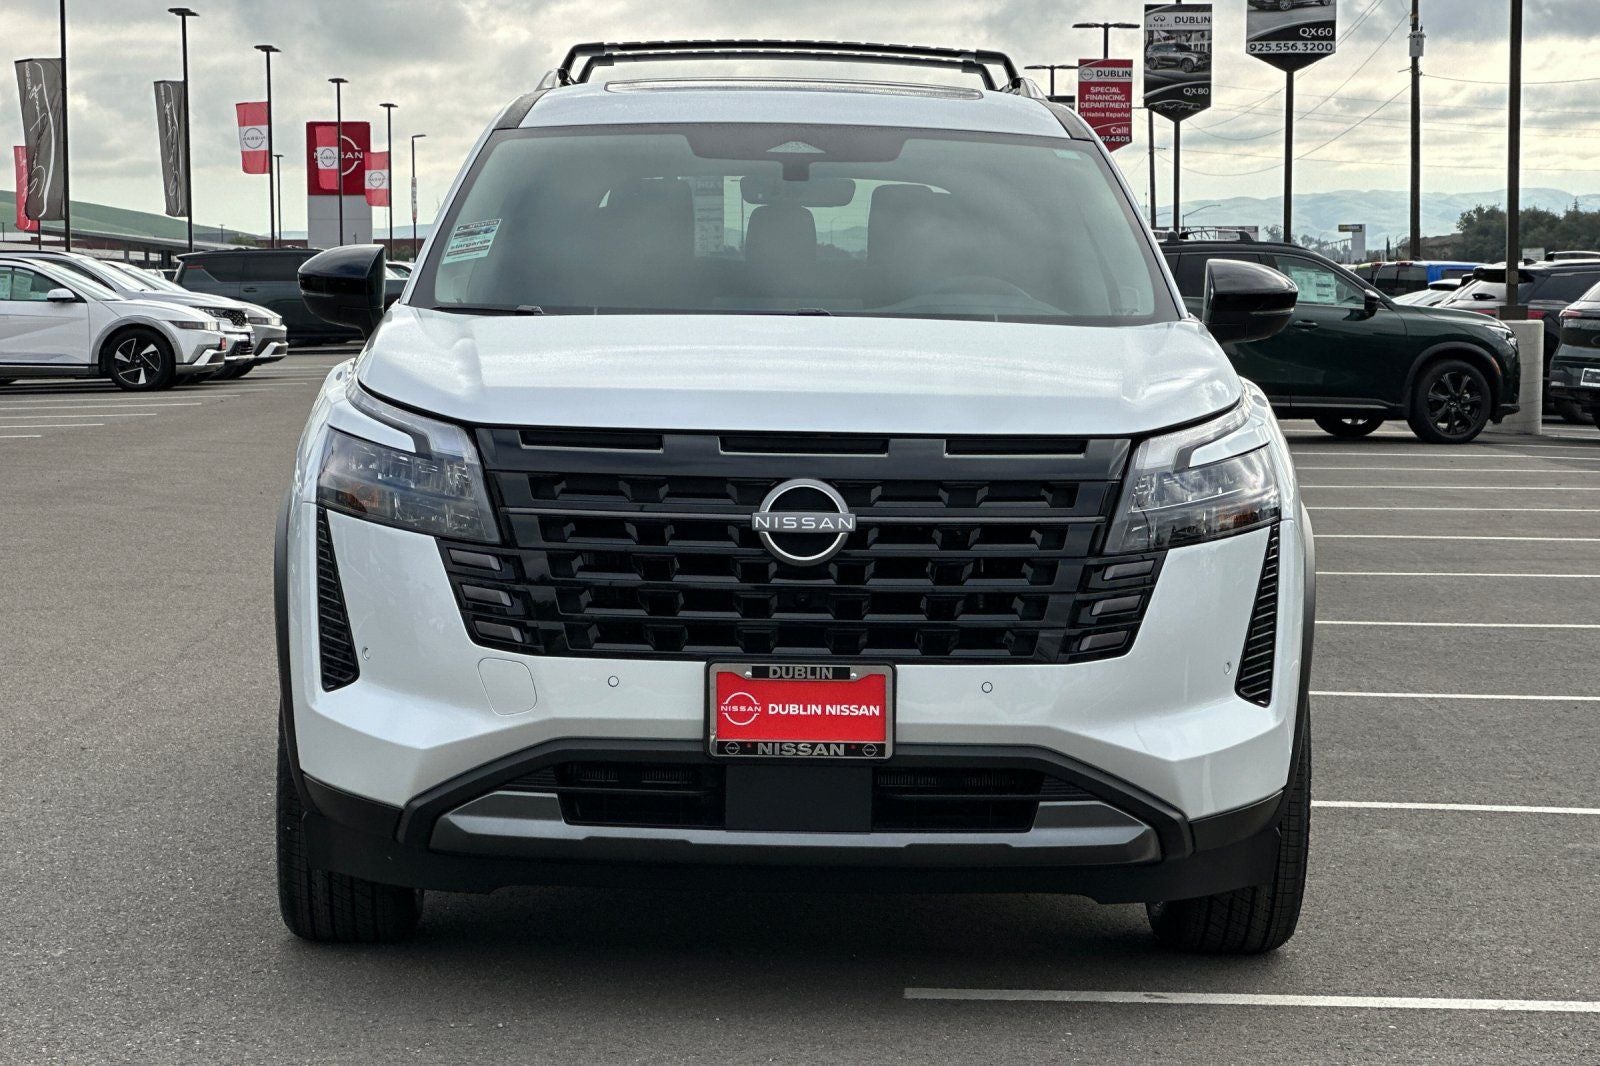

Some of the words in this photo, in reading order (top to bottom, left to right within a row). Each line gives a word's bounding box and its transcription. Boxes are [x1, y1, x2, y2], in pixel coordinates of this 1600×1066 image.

[1174, 16, 1211, 24] DUBLIN
[1299, 27, 1333, 38] QX60
[1249, 42, 1333, 52] 925.556.3200
[1096, 69, 1132, 77] DUBLIN
[1183, 87, 1209, 96] QX80
[1110, 126, 1129, 134] Call!
[755, 516, 853, 530] NISSAN
[768, 666, 833, 679] DUBLIN
[768, 703, 822, 715] DUBLIN
[825, 704, 880, 716] NISSAN
[757, 742, 845, 756] NISSAN
